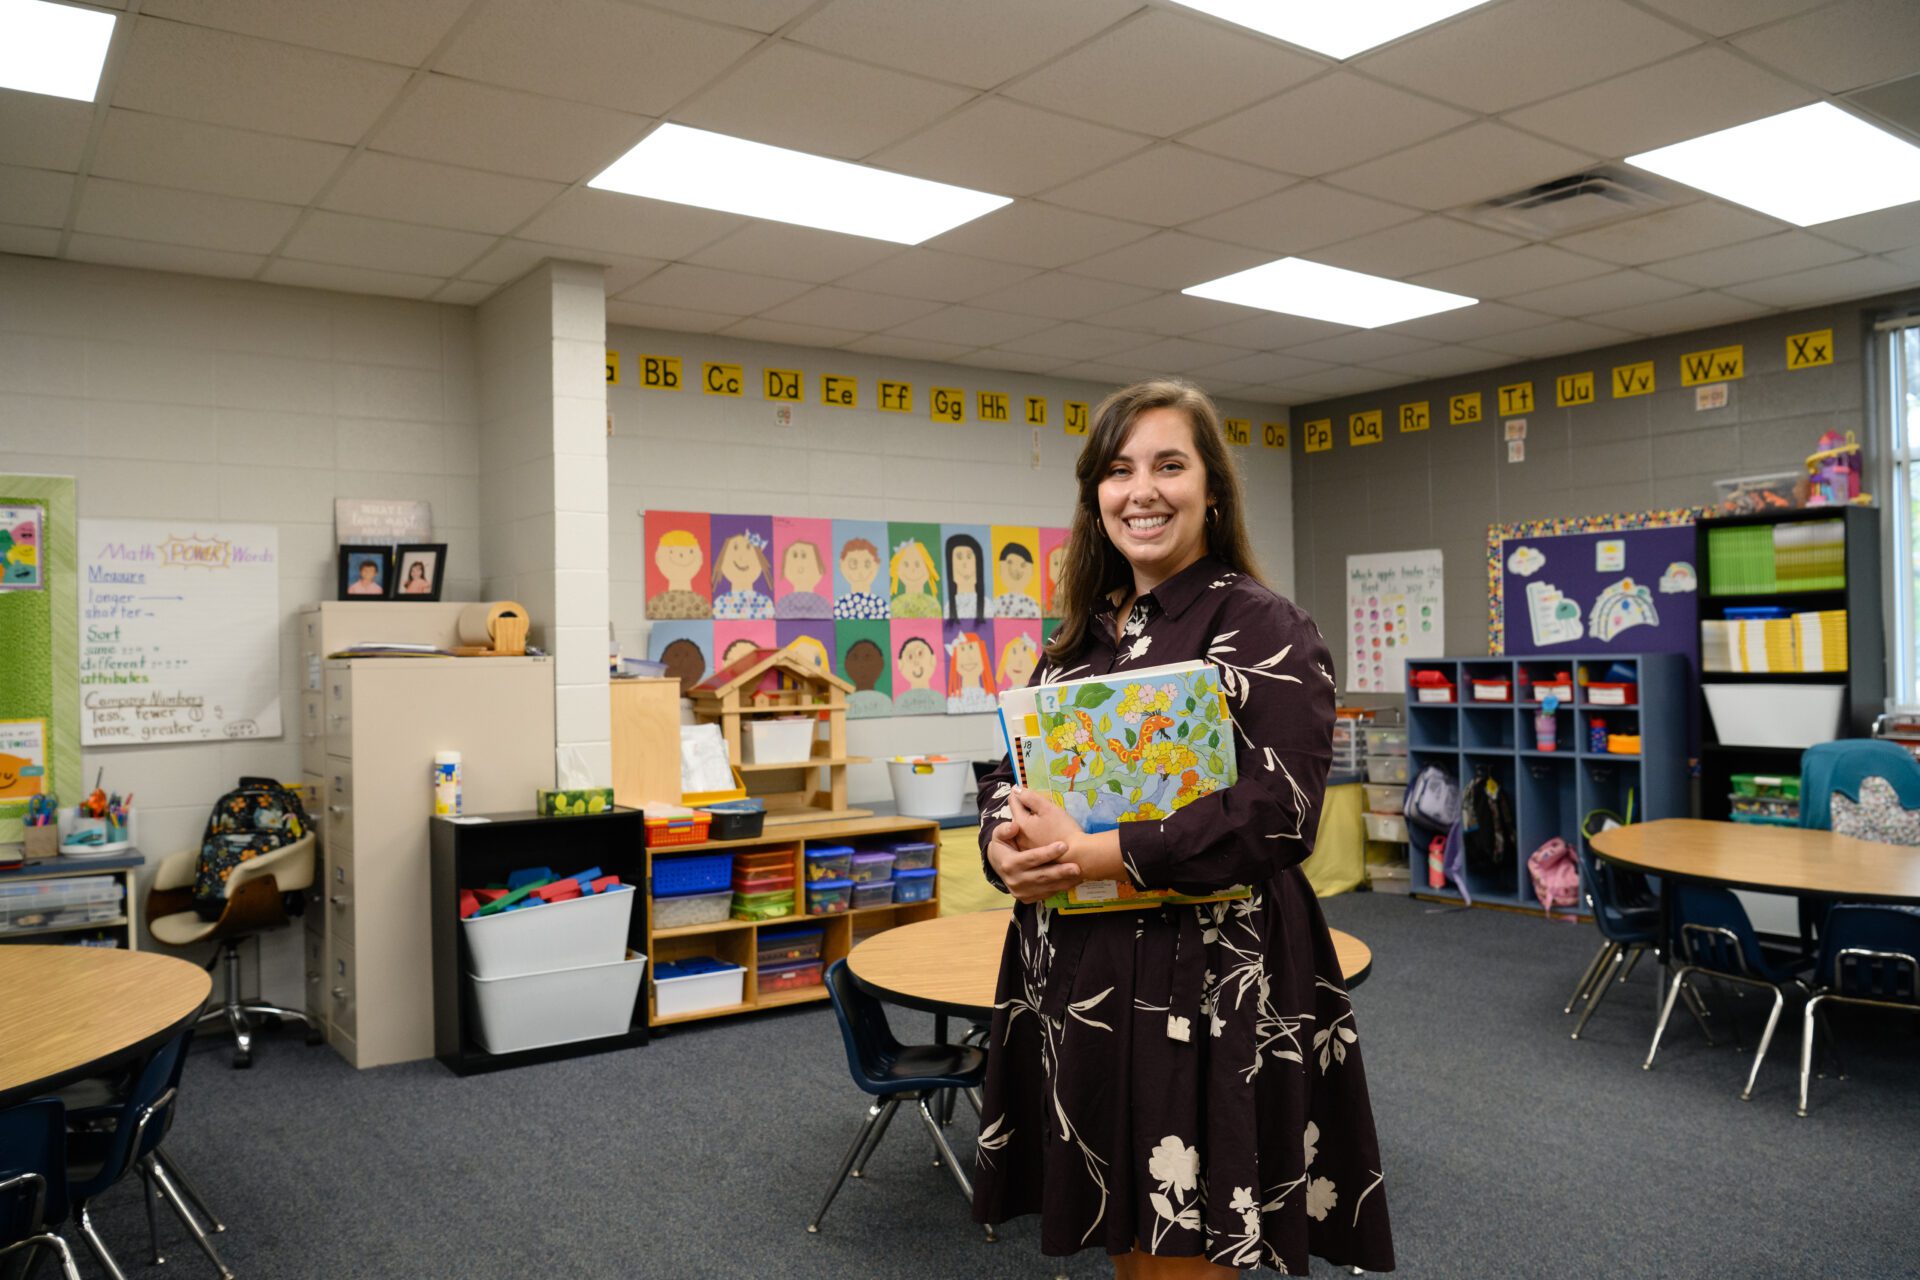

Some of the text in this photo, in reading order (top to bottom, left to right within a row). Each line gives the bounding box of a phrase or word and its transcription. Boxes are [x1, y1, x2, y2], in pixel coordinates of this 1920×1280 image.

[1790, 337, 1826, 364] Xx
[645, 358, 678, 387] Bb
[708, 366, 739, 393] Cc
[1686, 357, 1739, 380] Ww
[769, 371, 799, 398] Dd
[826, 378, 853, 404] Ee
[1561, 379, 1590, 401] Uu
[1618, 370, 1649, 392] Vv
[881, 383, 908, 409] Ff
[935, 390, 961, 420] Gg
[981, 394, 1007, 419] Hh
[1502, 388, 1530, 411] Tt
[1028, 397, 1043, 423] Ii
[1068, 403, 1086, 432] Jj
[1403, 407, 1425, 429] Rr
[1454, 398, 1478, 421] Ss
[1228, 420, 1247, 444] Nn
[1266, 425, 1284, 447] Oo
[1308, 424, 1328, 447] Pp
[1353, 416, 1380, 440] Qq
[98, 543, 273, 562] Math POWER Words
[88, 564, 145, 582] Measure
[88, 588, 136, 605] longer
[86, 624, 120, 641] Sort
[84, 645, 116, 655] same
[80, 655, 145, 670] different
[80, 671, 149, 684] attributes
[84, 690, 203, 709] Compare Numbers
[1046, 695, 1055, 709] ?
[135, 707, 176, 720] fewer
[141, 720, 193, 740] greater
